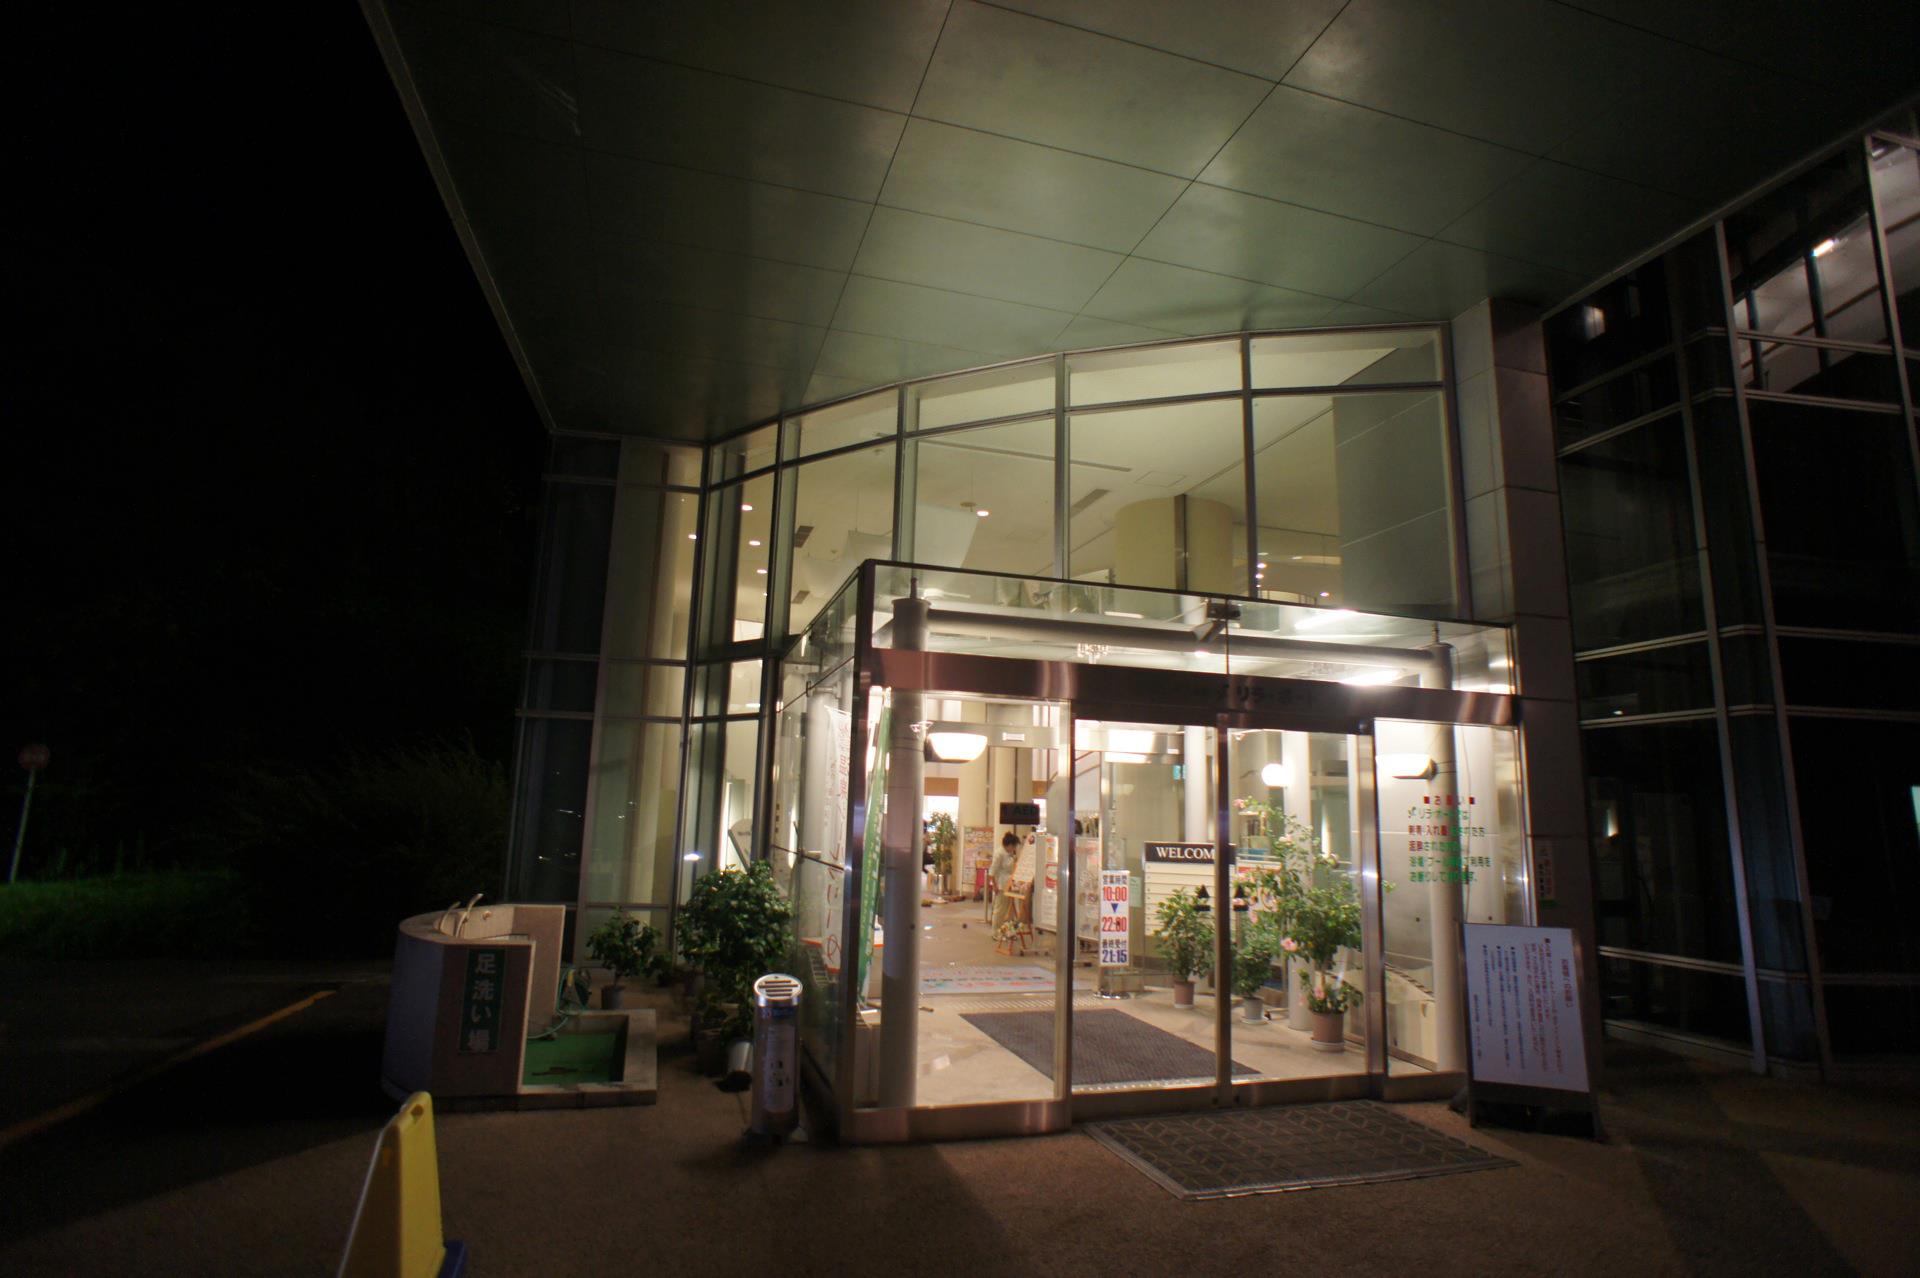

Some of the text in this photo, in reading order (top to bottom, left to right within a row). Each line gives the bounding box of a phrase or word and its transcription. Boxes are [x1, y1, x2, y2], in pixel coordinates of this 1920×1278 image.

[1156, 846, 1216, 860] WELCOM
[1103, 886, 1127, 902] 10:00
[1102, 949, 1127, 963] 21:15
